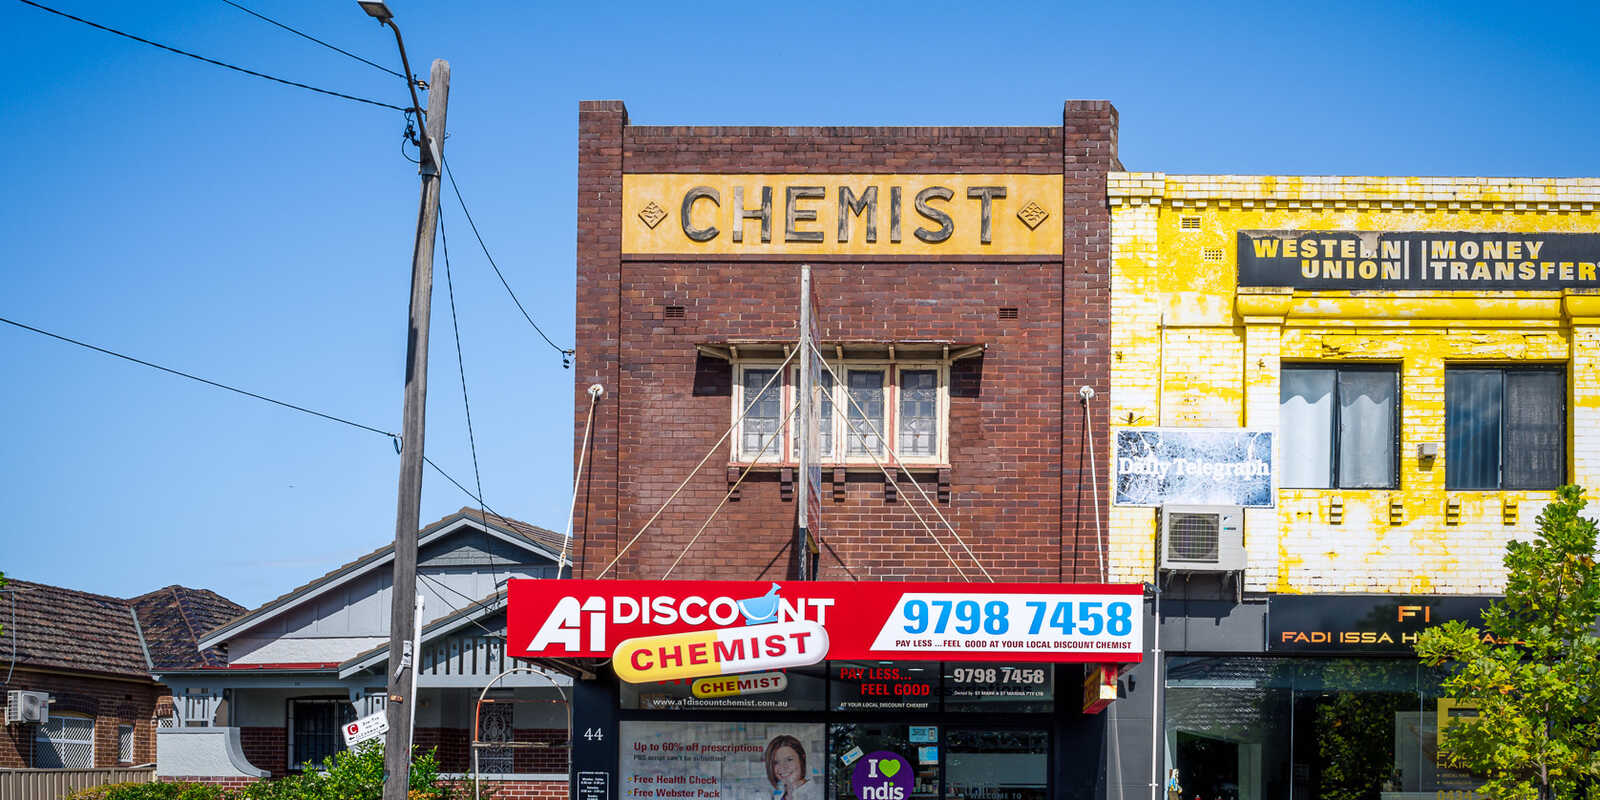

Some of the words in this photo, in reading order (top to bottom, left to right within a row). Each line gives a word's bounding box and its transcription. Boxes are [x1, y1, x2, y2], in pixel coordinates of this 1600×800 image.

[680, 185, 1007, 244] CHEMIST
[1431, 240, 1544, 260] MONEY
[1301, 260, 1401, 280] UNION
[1430, 261, 1597, 281] TRANSFER
[1118, 456, 1169, 480] Daily
[1173, 458, 1270, 480] Telegraph
[903, 599, 1009, 636] 9798
[1025, 601, 1132, 637] 7458
[1397, 605, 1430, 623] FI
[895, 639, 911, 647] PAY
[913, 639, 933, 647] LESS
[964, 640, 987, 648] GOOD
[989, 640, 999, 648] AT
[1001, 640, 1024, 648] YOUR
[1026, 641, 1052, 649] LOCAL
[1053, 641, 1094, 649] DISCOUNT
[1095, 641, 1132, 649] CHEMIST
[1281, 631, 1331, 643] FADI
[1339, 631, 1394, 643] ISSA
[630, 631, 811, 672] CHEMIST
[840, 668, 864, 680] PAY
[868, 668, 912, 681] LESS...
[953, 668, 996, 683] 9798
[1001, 668, 1044, 684] 7458
[700, 676, 782, 694] CHEMIST
[861, 683, 890, 696] FEEL
[894, 683, 930, 696] GOOD
[653, 697, 788, 708] www.a1discountchemist.com.au
[583, 727, 603, 741] 44
[633, 742, 647, 753] Up
[649, 742, 659, 751] to
[662, 742, 684, 752] 60%
[686, 742, 699, 752] off
[701, 742, 764, 754] prescriptions
[633, 775, 654, 783] Free
[656, 775, 686, 784] Health
[689, 775, 717, 784] Check
[633, 788, 654, 797] Free
[656, 788, 694, 798] Webster
[697, 788, 720, 798] Pack
[863, 782, 904, 800] ndis
